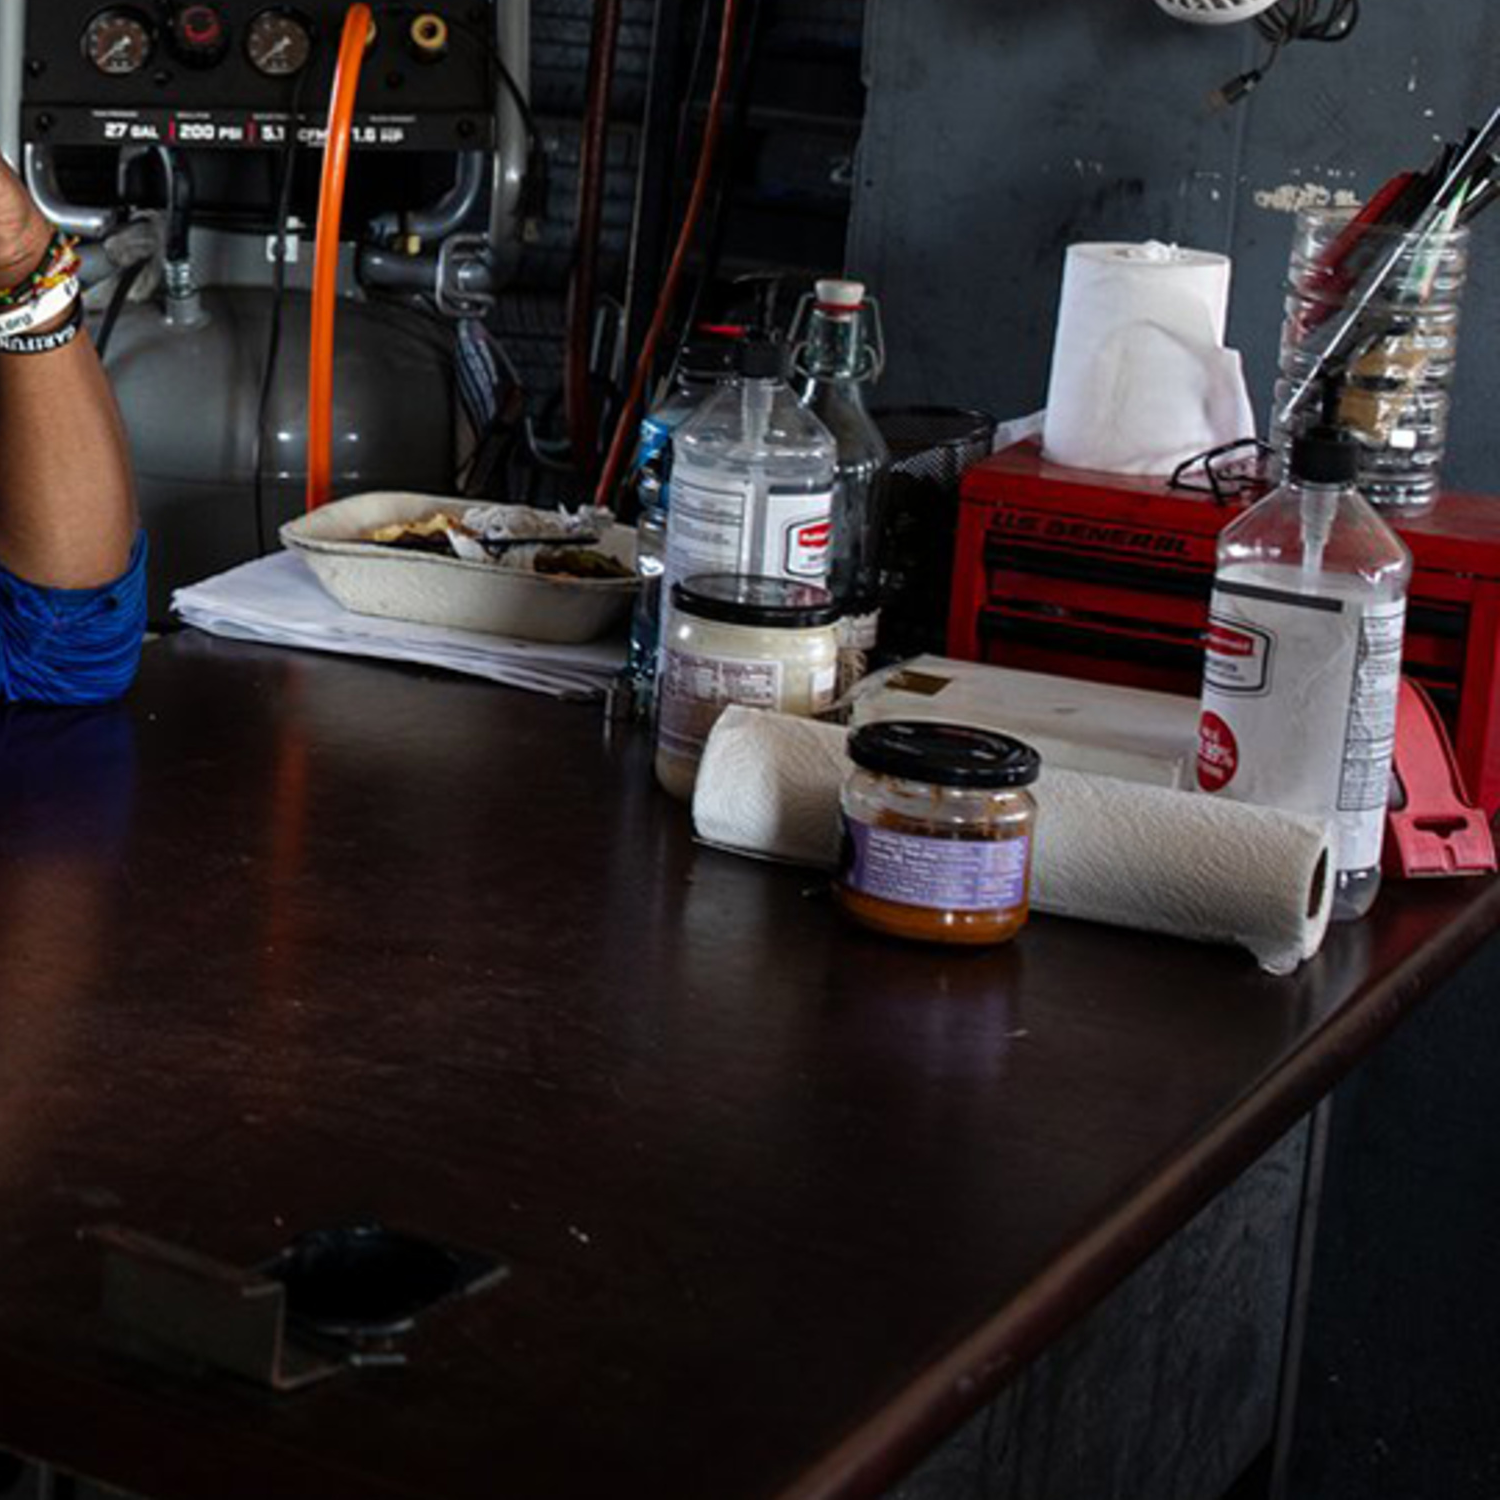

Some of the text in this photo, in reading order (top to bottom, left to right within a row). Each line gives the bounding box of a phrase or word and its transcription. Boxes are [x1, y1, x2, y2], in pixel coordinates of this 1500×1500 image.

[104, 121, 159, 140] 27 GAL
[179, 123, 243, 140] 200 PSI
[261, 125, 284, 141] 5.1
